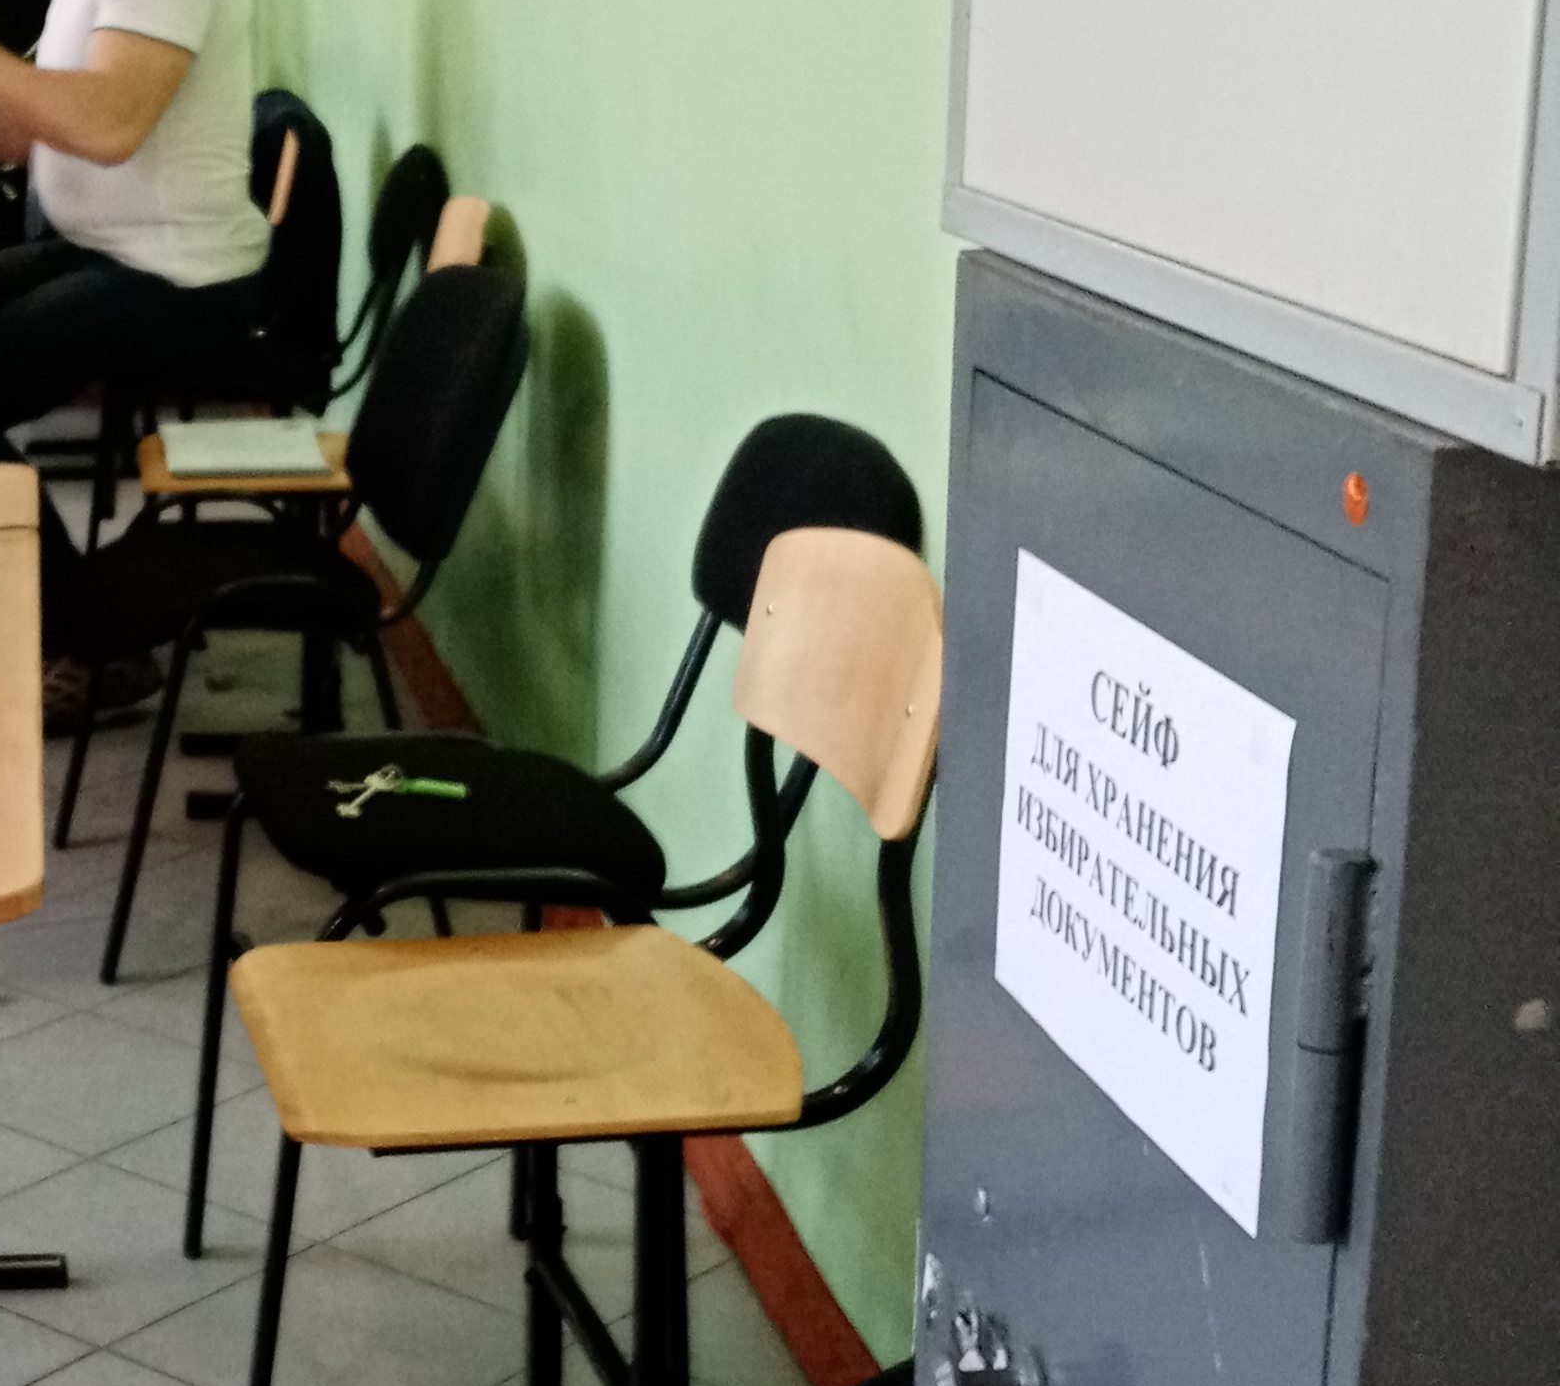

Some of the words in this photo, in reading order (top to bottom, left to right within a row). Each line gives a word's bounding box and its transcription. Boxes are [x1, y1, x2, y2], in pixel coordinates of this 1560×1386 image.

[1090, 668, 1181, 770] СЕЙФ
[1016, 783, 1251, 1018] ИЗБИРАТЕЛЬНЫХ
[1030, 720, 1081, 794] ДЛЯ
[1084, 759, 1241, 920] ХРАНЕНИЯ
[1029, 874, 1217, 1073] ДОКУМЕНТОВ
